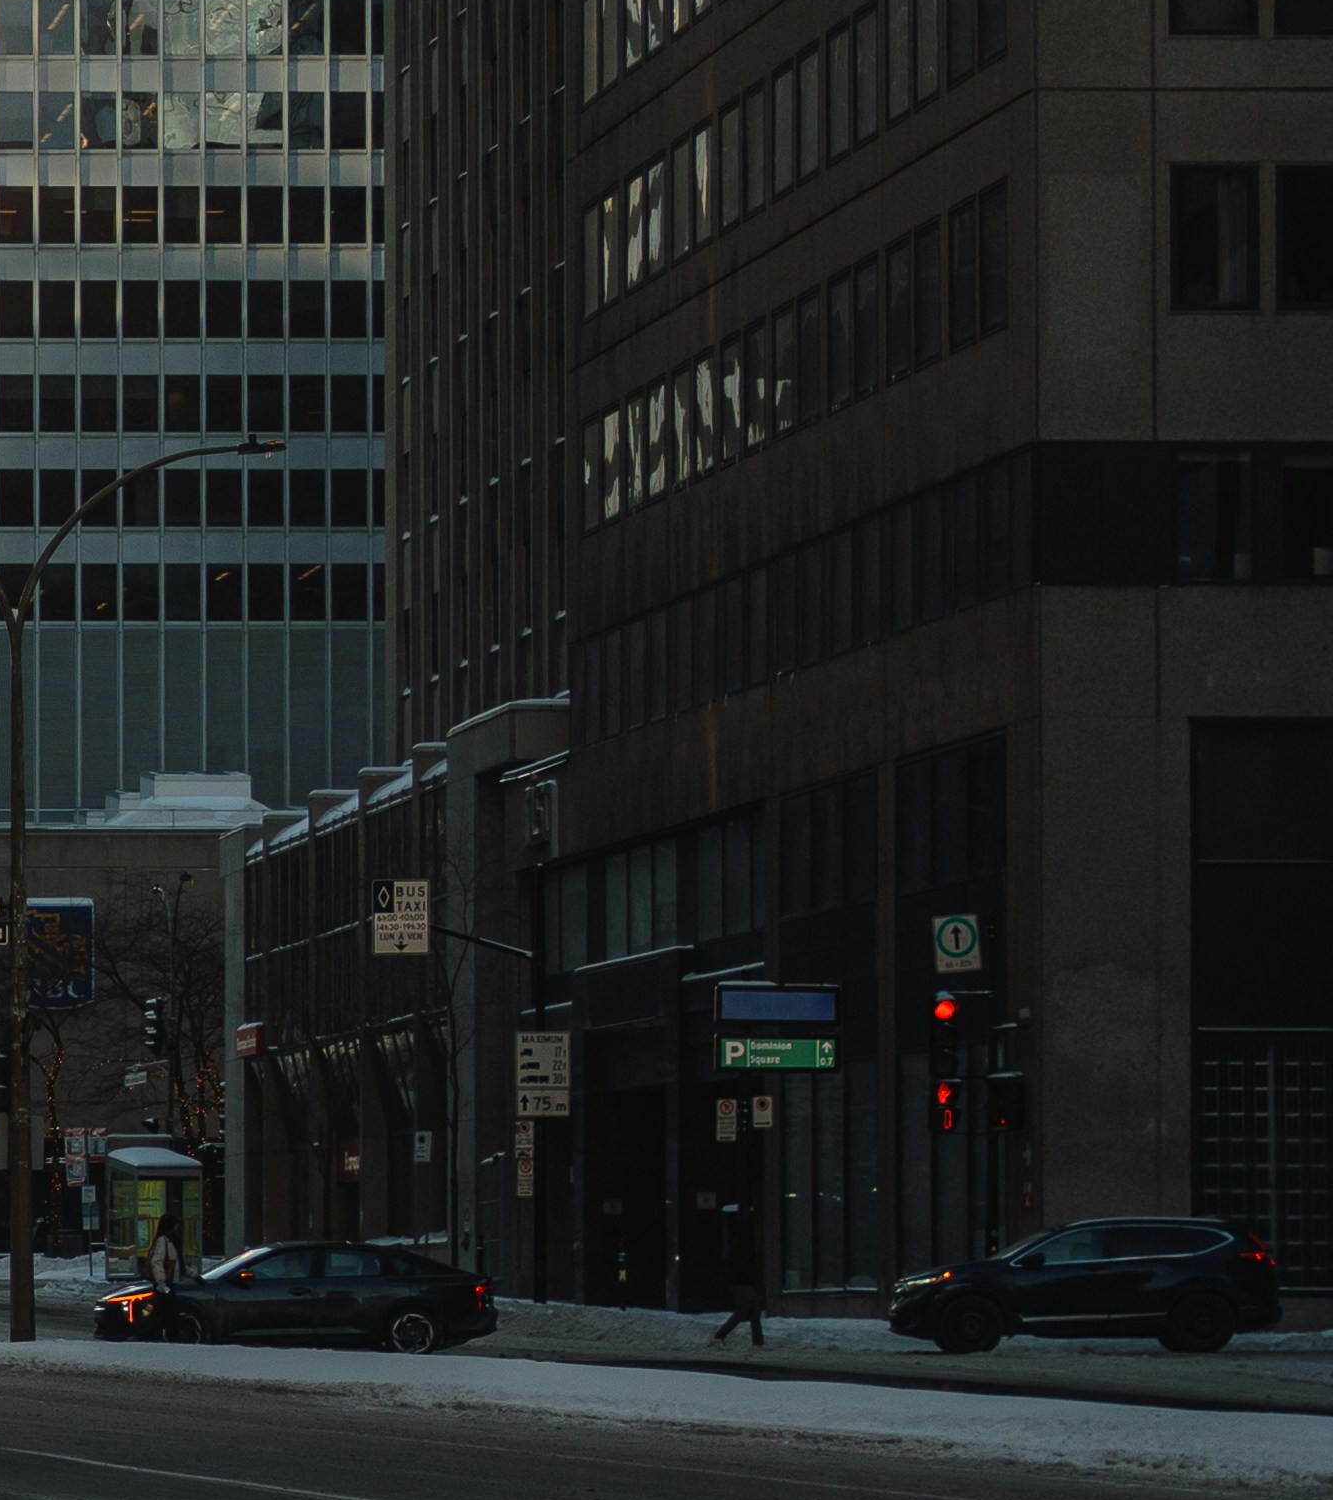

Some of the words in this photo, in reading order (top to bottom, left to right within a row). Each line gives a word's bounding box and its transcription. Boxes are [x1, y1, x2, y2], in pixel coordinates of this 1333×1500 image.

[396, 886, 425, 897] BUS
[396, 901, 426, 911] TAXI
[522, 1035, 563, 1043] MAXIMUM
[750, 1041, 793, 1050] Dominion
[749, 1055, 781, 1065] Square
[532, 1097, 551, 1111] 75
[555, 1102, 567, 1111] m
